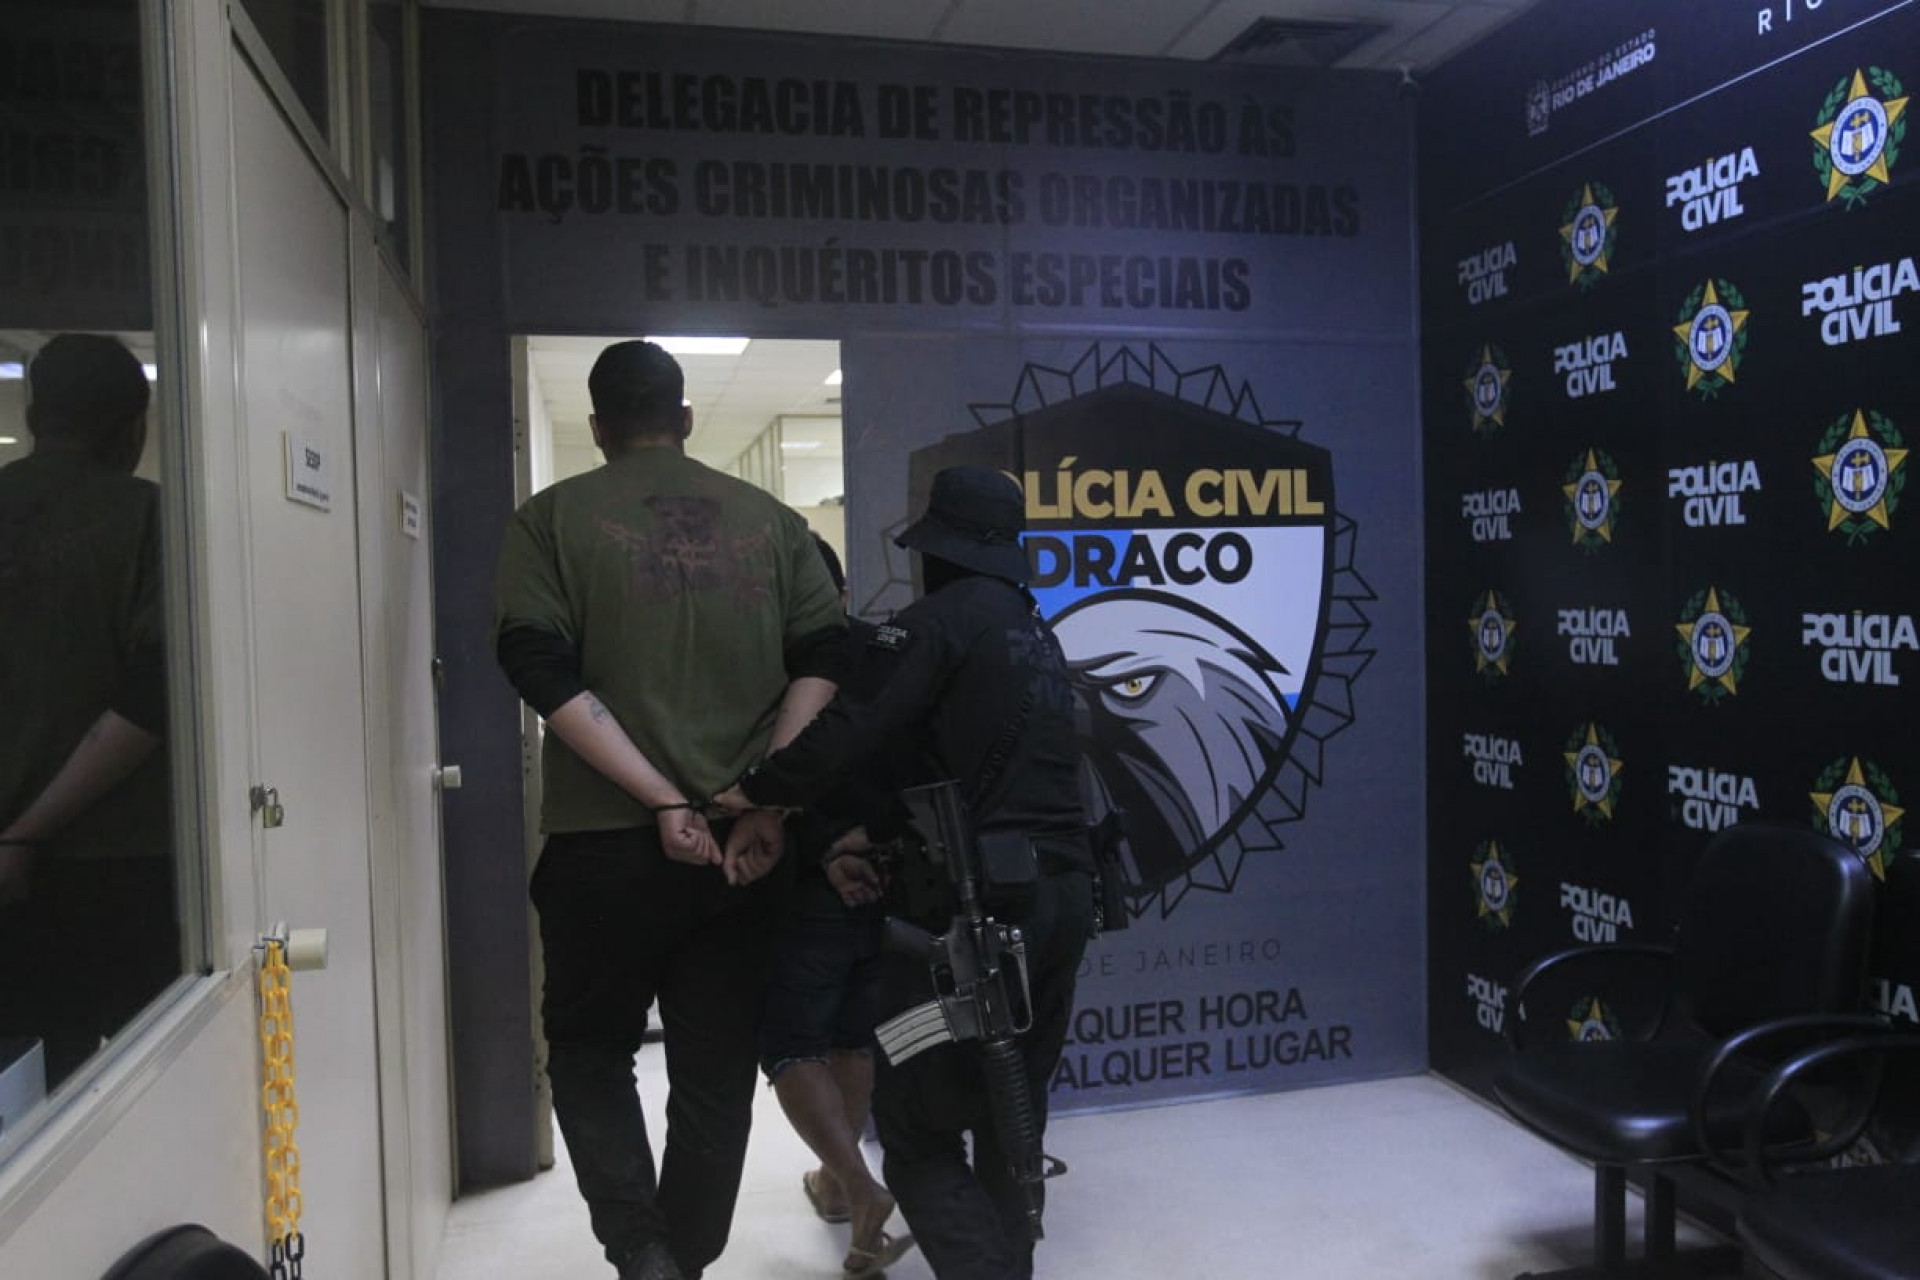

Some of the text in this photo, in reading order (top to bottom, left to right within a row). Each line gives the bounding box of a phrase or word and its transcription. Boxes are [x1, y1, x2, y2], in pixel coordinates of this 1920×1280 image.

[1553, 42, 1656, 111] RIO DE JANEIRO
[577, 68, 1297, 158] DELEGACIA DE REPRESSÃO ÀS
[499, 144, 1360, 238] AÇÕES CRIMINOSAS ORGANIZADAS
[1682, 186, 1744, 231] CIVIL
[644, 237, 1252, 312] E INQUÉRITOS ESPECIAIS
[1468, 271, 1508, 305] CIVIL
[1821, 299, 1901, 346] CIVIL
[1566, 363, 1617, 398] CIVIL
[1001, 454, 1325, 519] LÍCIA CIVIL
[1473, 515, 1512, 541] CIVIL
[1684, 494, 1746, 527] CIVIL
[1024, 532, 1253, 588] DRACO
[1570, 637, 1619, 666] CIVIL
[1821, 648, 1899, 686] CIVIL
[1474, 760, 1514, 789] CIVIL
[1135, 938, 1282, 973] JANEIRO
[1063, 987, 1308, 1046] QUER HORA
[1050, 1025, 1353, 1092] ALQUER LUGAR
